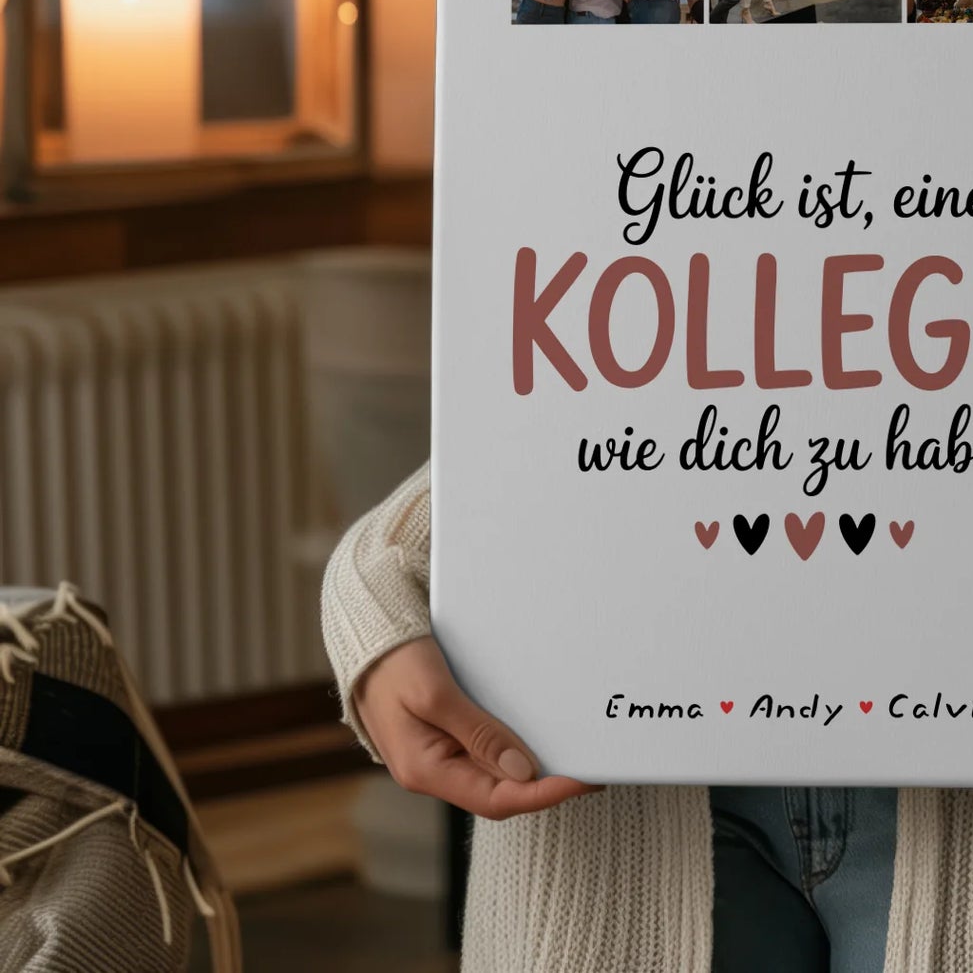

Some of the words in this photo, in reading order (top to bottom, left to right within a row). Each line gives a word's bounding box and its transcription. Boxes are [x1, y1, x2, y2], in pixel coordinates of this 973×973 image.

[616, 146, 785, 246] Glück
[797, 159, 874, 231] ist,
[577, 426, 666, 473] wie
[678, 403, 794, 472] dich
[802, 436, 873, 497] zu
[605, 693, 704, 720] Emma
[749, 693, 844, 727] Andy
